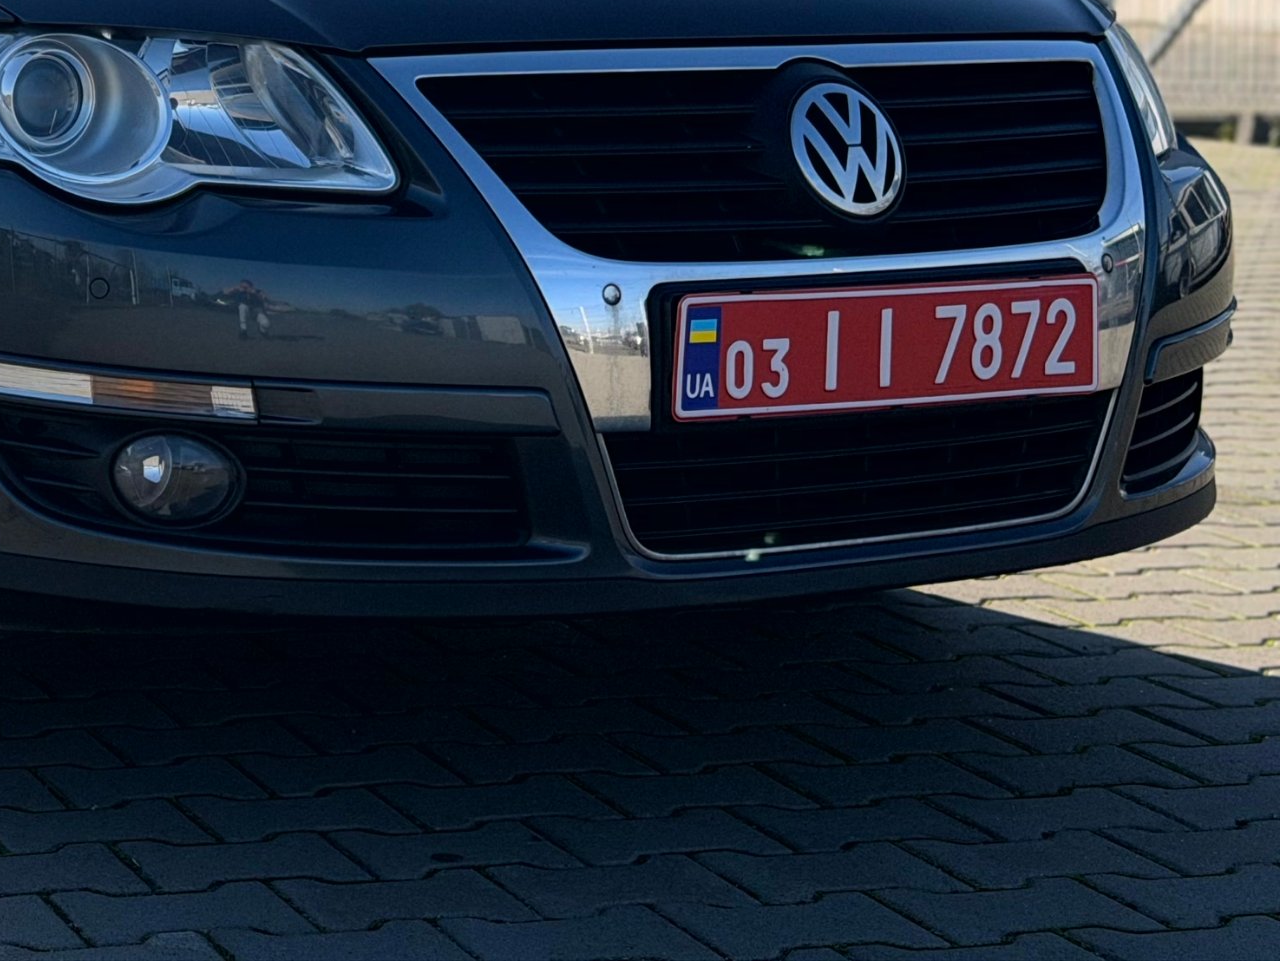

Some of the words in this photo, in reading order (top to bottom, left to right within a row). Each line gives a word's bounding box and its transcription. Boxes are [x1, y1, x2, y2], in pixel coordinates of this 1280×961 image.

[791, 83, 902, 215] VW
[935, 297, 1077, 384] 7872
[686, 373, 714, 399] UA
